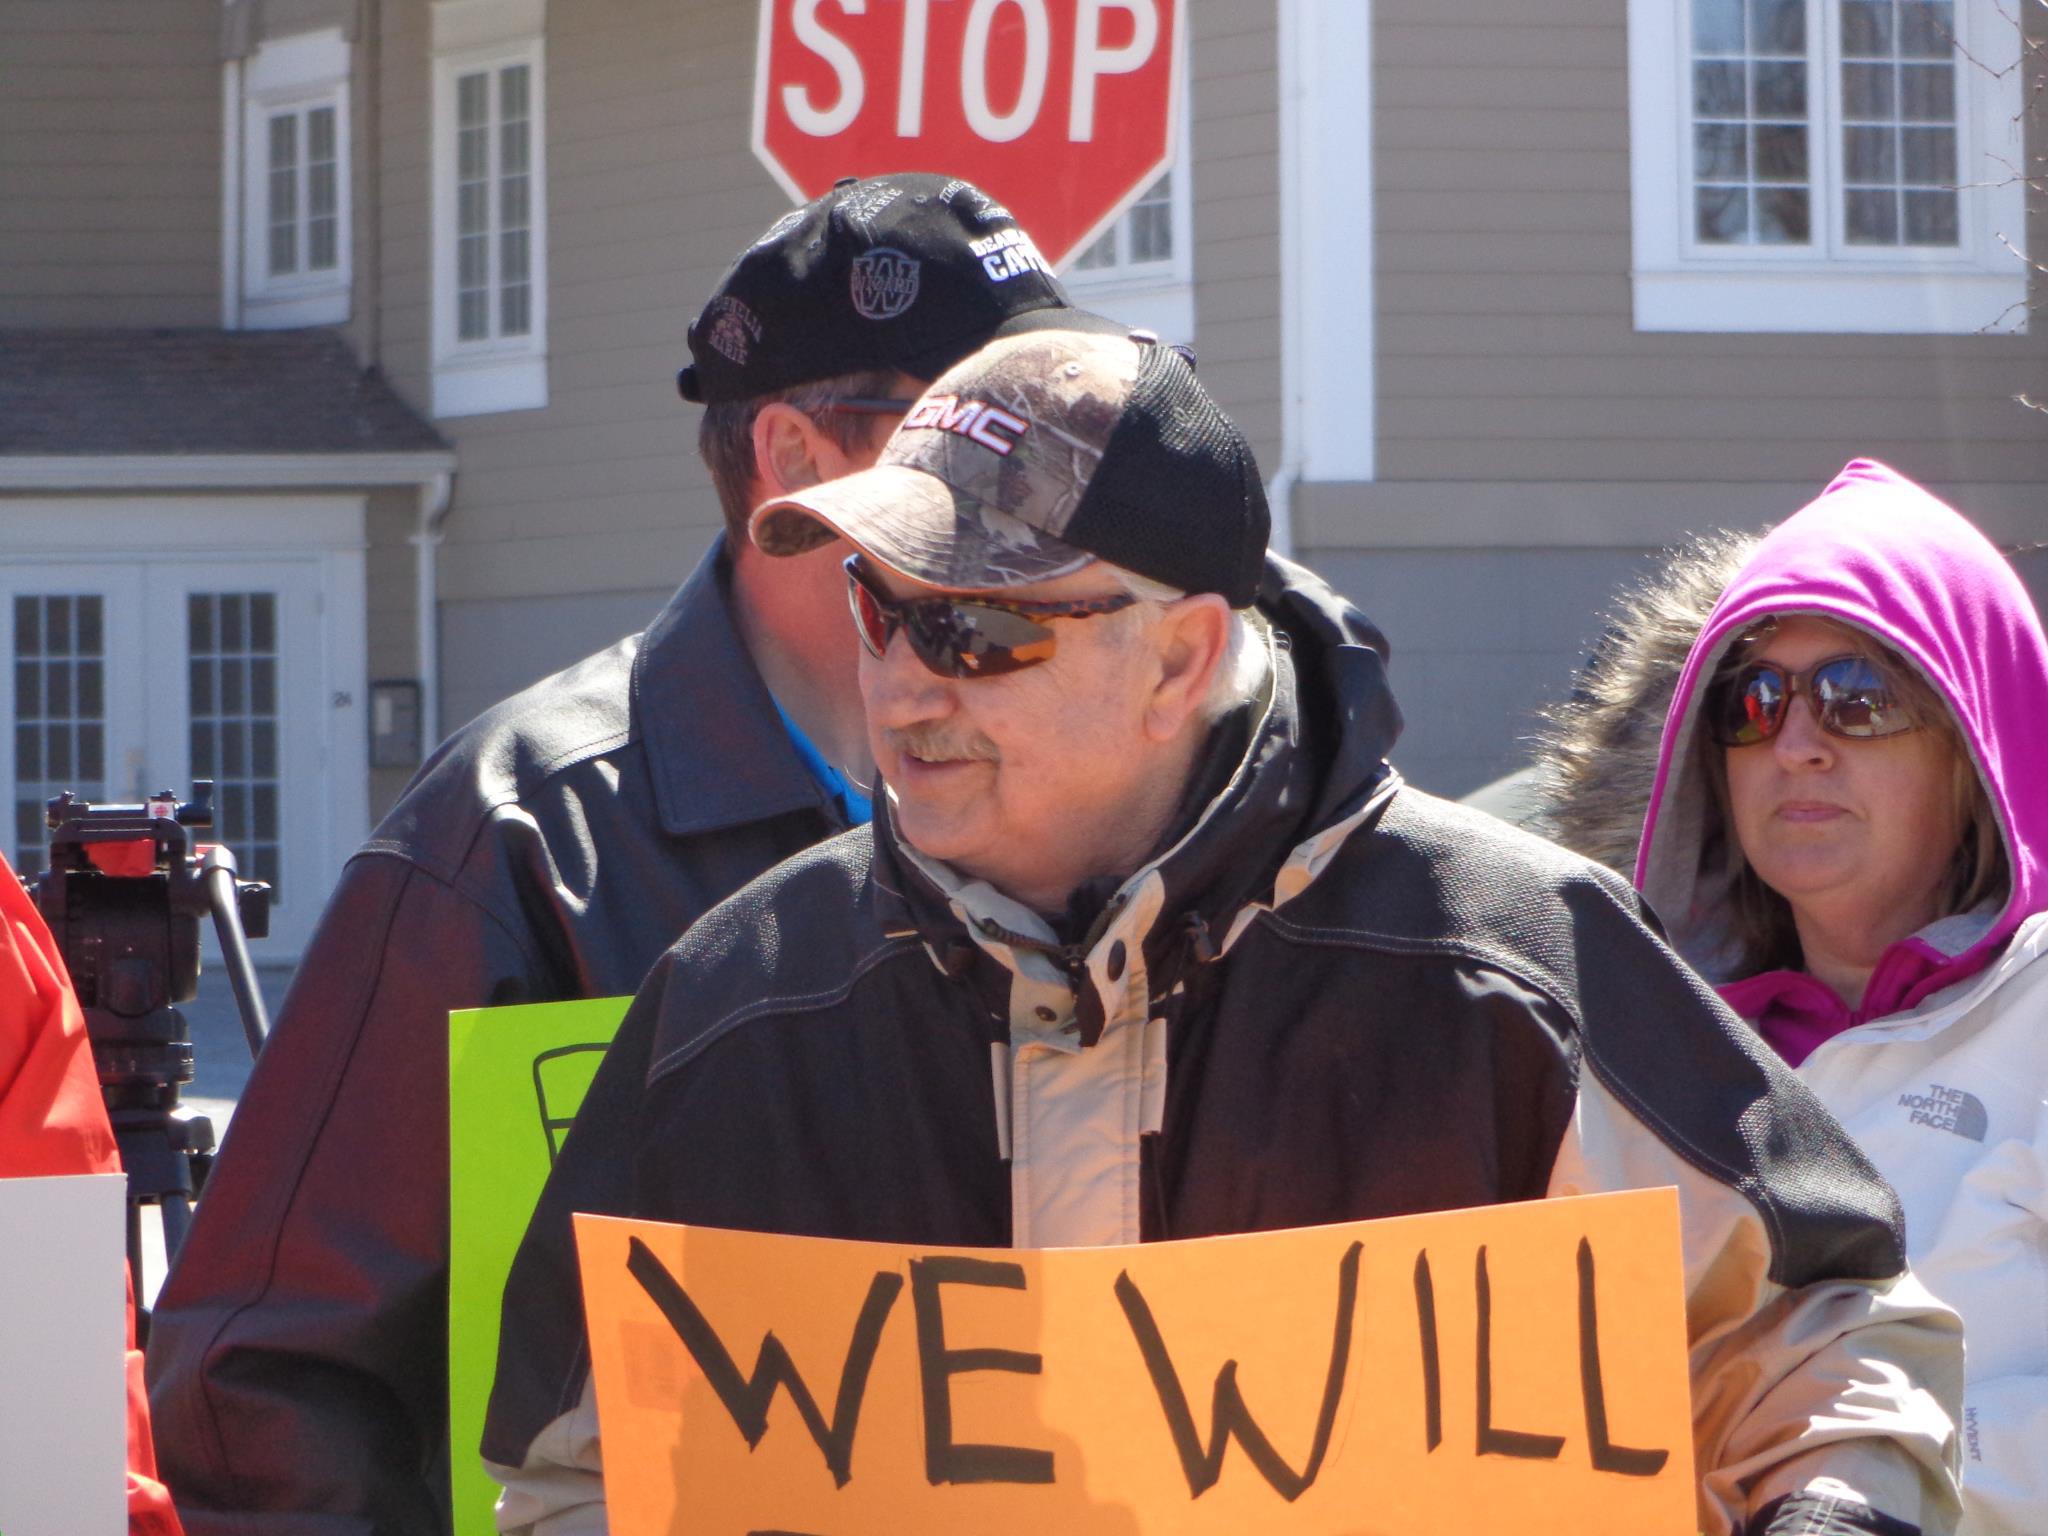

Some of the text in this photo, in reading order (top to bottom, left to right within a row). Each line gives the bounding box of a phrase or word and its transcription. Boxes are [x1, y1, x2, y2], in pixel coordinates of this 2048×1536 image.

[782, 0, 1159, 142] STOP
[903, 394, 1029, 457] GMC
[1897, 1093, 1960, 1118] NORTH
[1929, 1083, 1962, 1104] THE
[1909, 1110, 1955, 1132] FACE
[627, 1236, 1669, 1503] WE WILL
